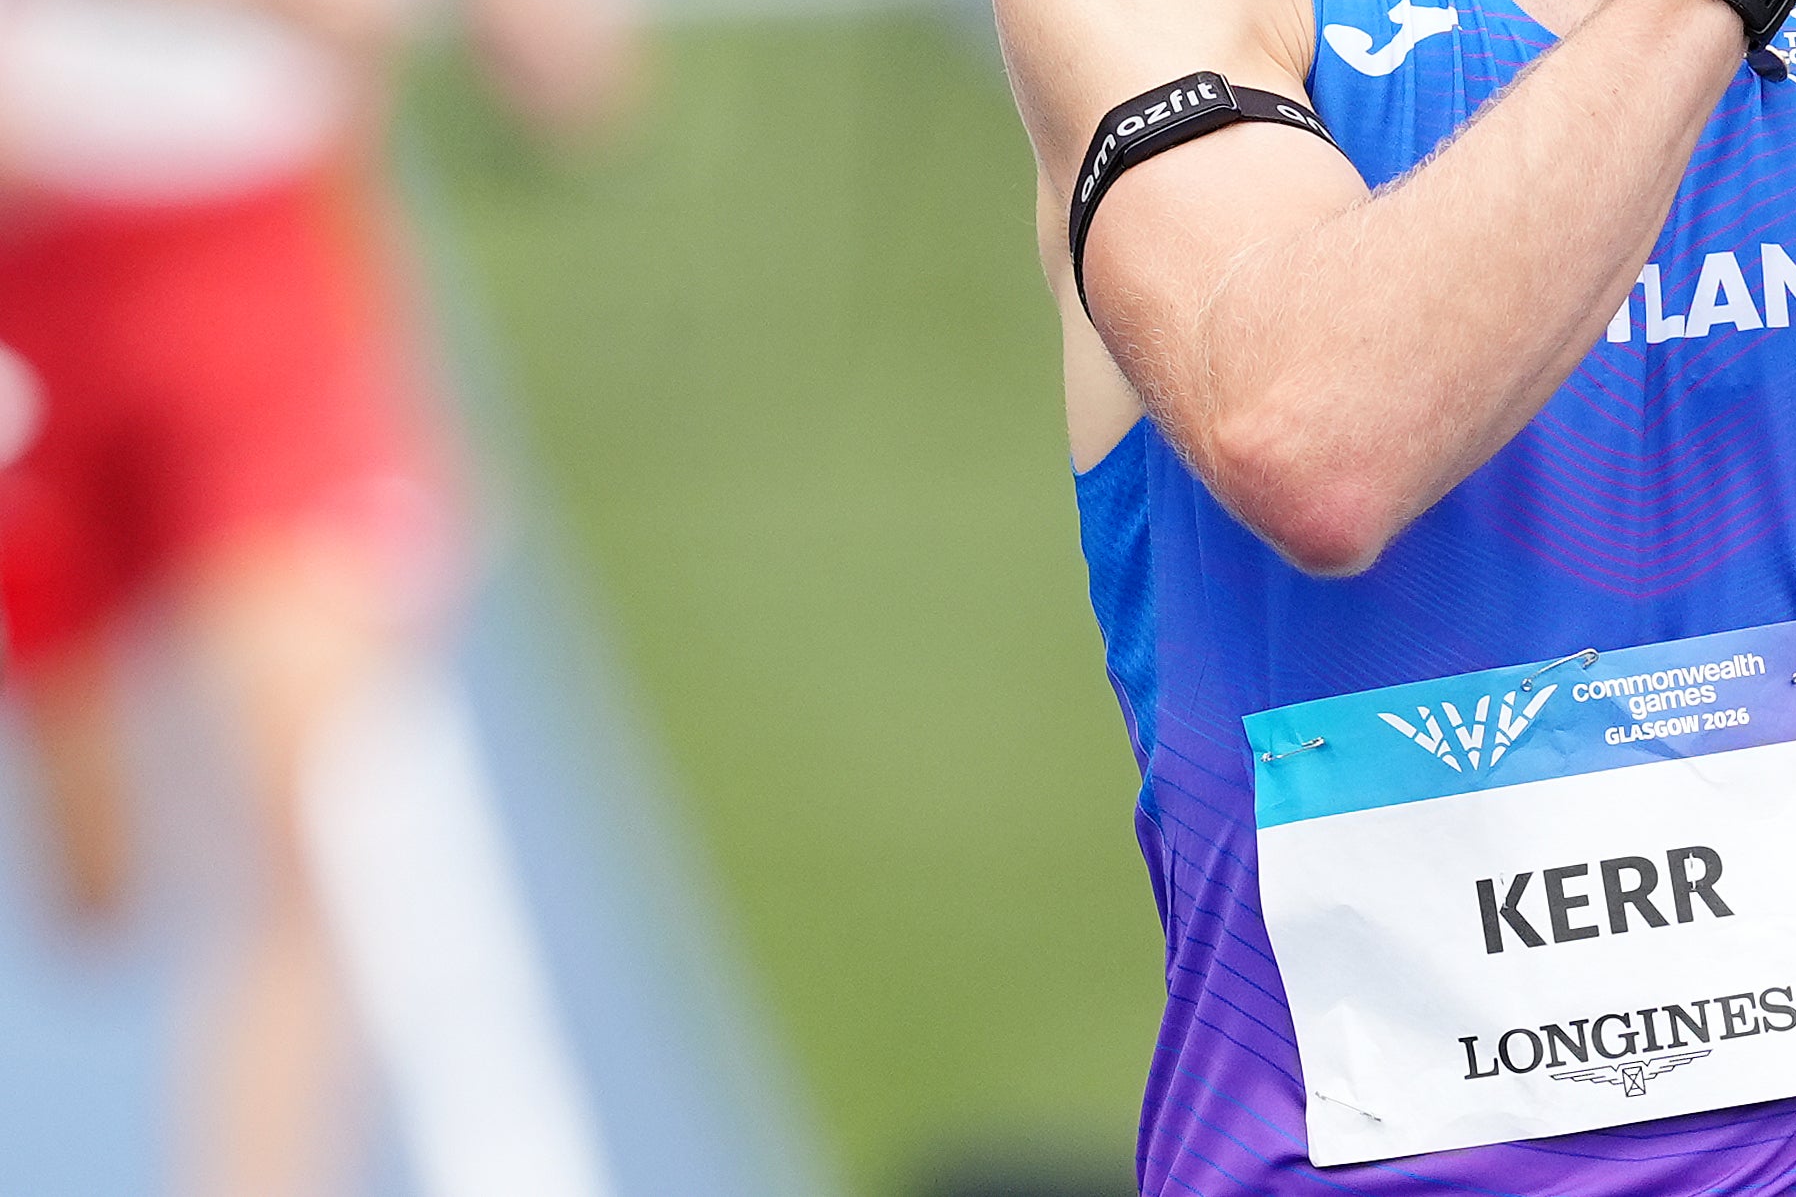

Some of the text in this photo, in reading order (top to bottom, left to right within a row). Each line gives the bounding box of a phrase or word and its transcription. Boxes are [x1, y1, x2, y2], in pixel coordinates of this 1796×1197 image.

[1081, 82, 1217, 203] amazfit
[1572, 652, 1766, 703] commonwealth
[1628, 684, 1718, 721] games
[1604, 706, 1751, 746] GLASGOW 2026
[1475, 845, 1735, 955] KERR
